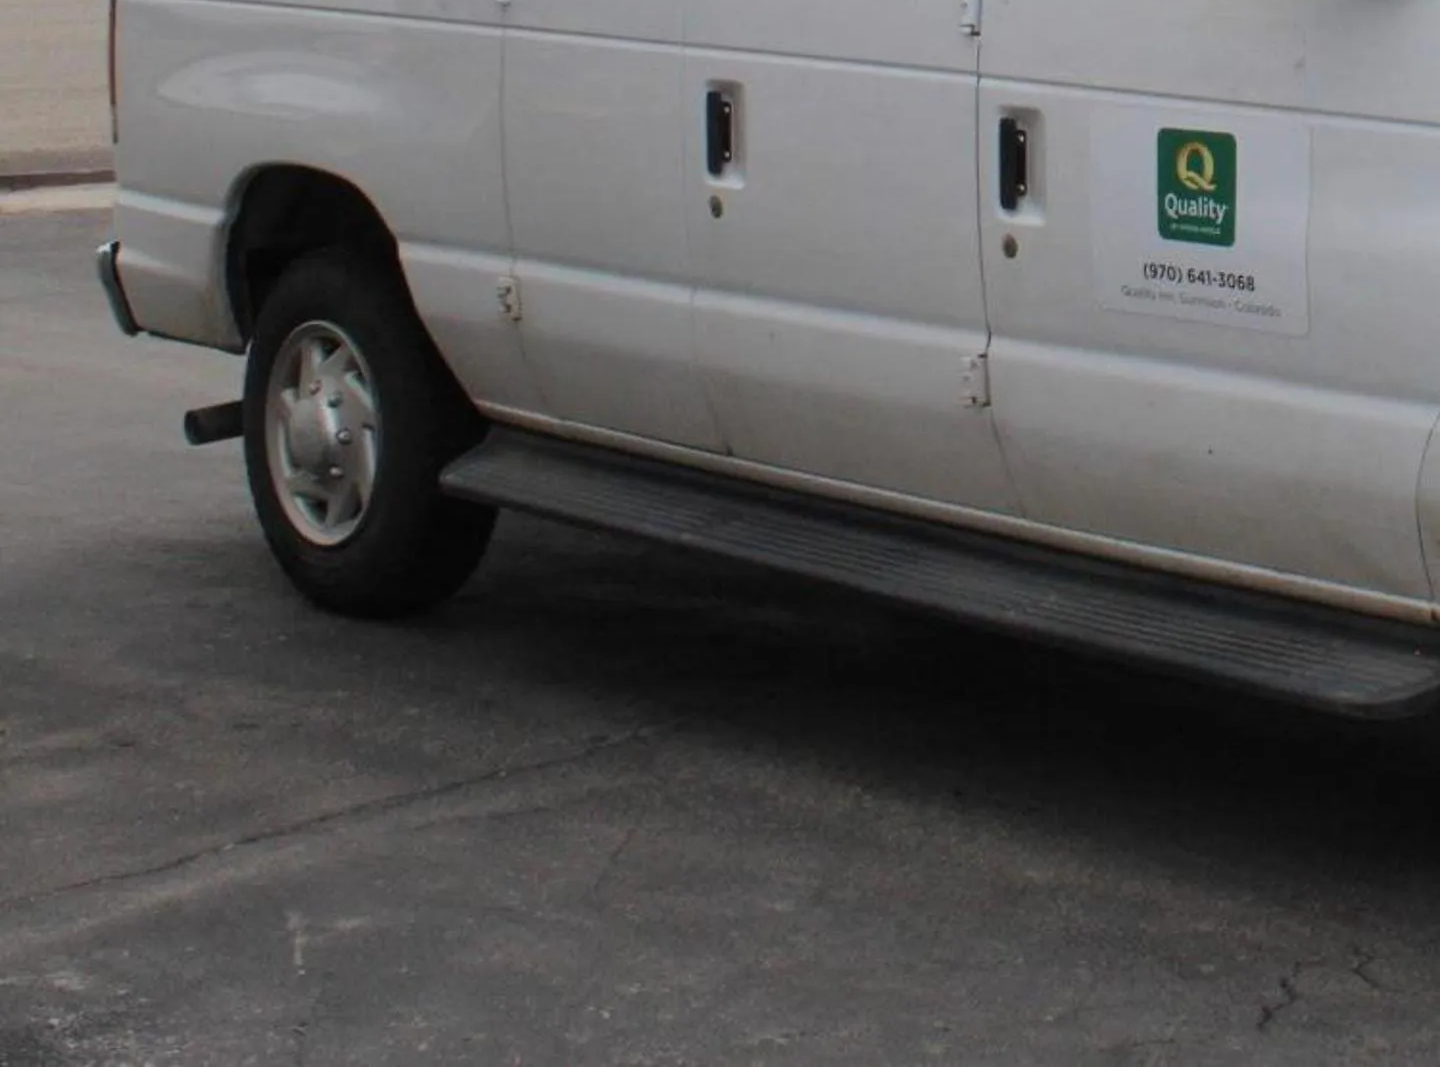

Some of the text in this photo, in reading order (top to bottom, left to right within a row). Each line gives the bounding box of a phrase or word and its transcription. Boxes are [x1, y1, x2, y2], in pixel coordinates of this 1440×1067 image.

[1177, 142, 1217, 191] Q
[1165, 193, 1227, 224] Quality
[1144, 263, 1255, 292] (970) 641-3068
